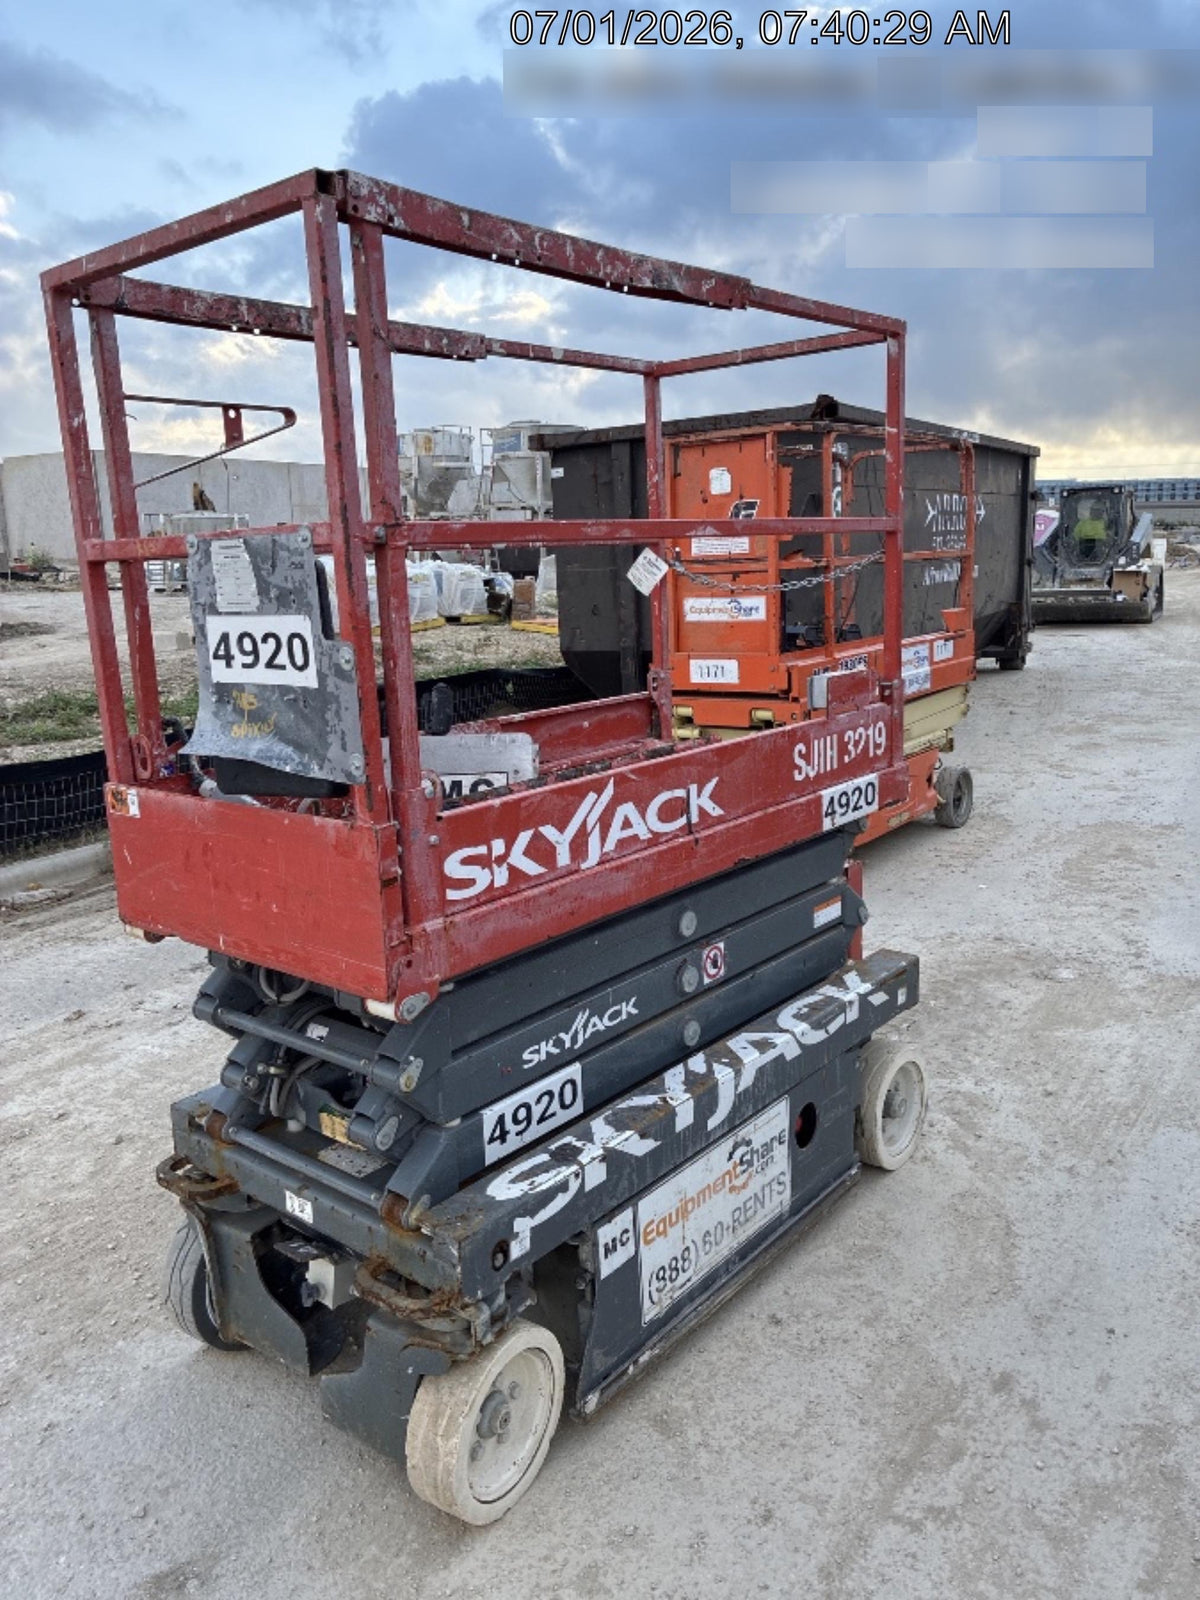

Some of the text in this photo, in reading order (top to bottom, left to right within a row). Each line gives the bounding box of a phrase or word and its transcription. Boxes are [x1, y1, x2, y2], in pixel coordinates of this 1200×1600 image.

[212, 631, 310, 672] 4920
[843, 721, 886, 763] 3219
[825, 782, 876, 820] 4920
[443, 776, 724, 900] SKYJACK
[522, 995, 638, 1069] SKYJACK
[486, 1078, 579, 1147] 4920
[604, 1228, 630, 1260] MC
